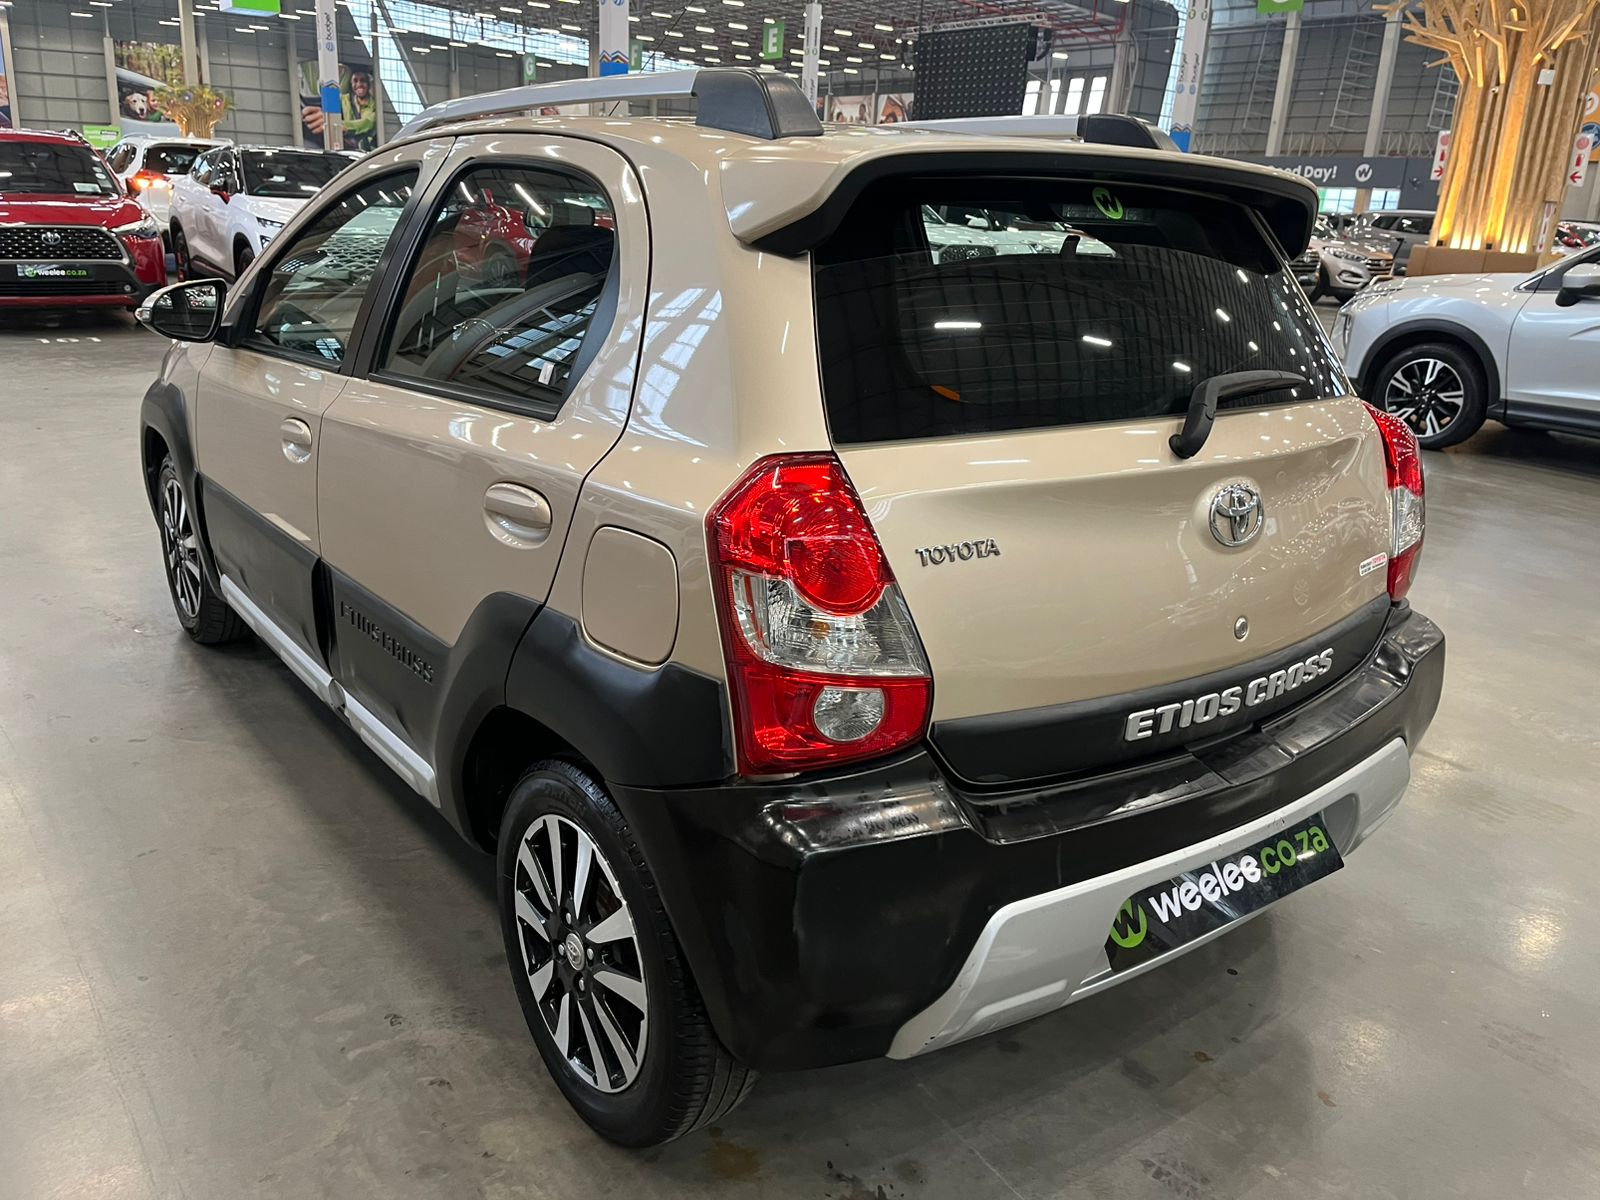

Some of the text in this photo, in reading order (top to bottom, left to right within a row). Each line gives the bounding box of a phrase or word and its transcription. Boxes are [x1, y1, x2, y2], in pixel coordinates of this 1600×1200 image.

[768, 28, 778, 53] E
[525, 57, 535, 76] G
[1304, 165, 1338, 183] Day!
[914, 538, 1001, 567] TOYOTA
[1124, 647, 1334, 742] ETIOS CROSS
[1149, 826, 1330, 923] weelee.co.za
